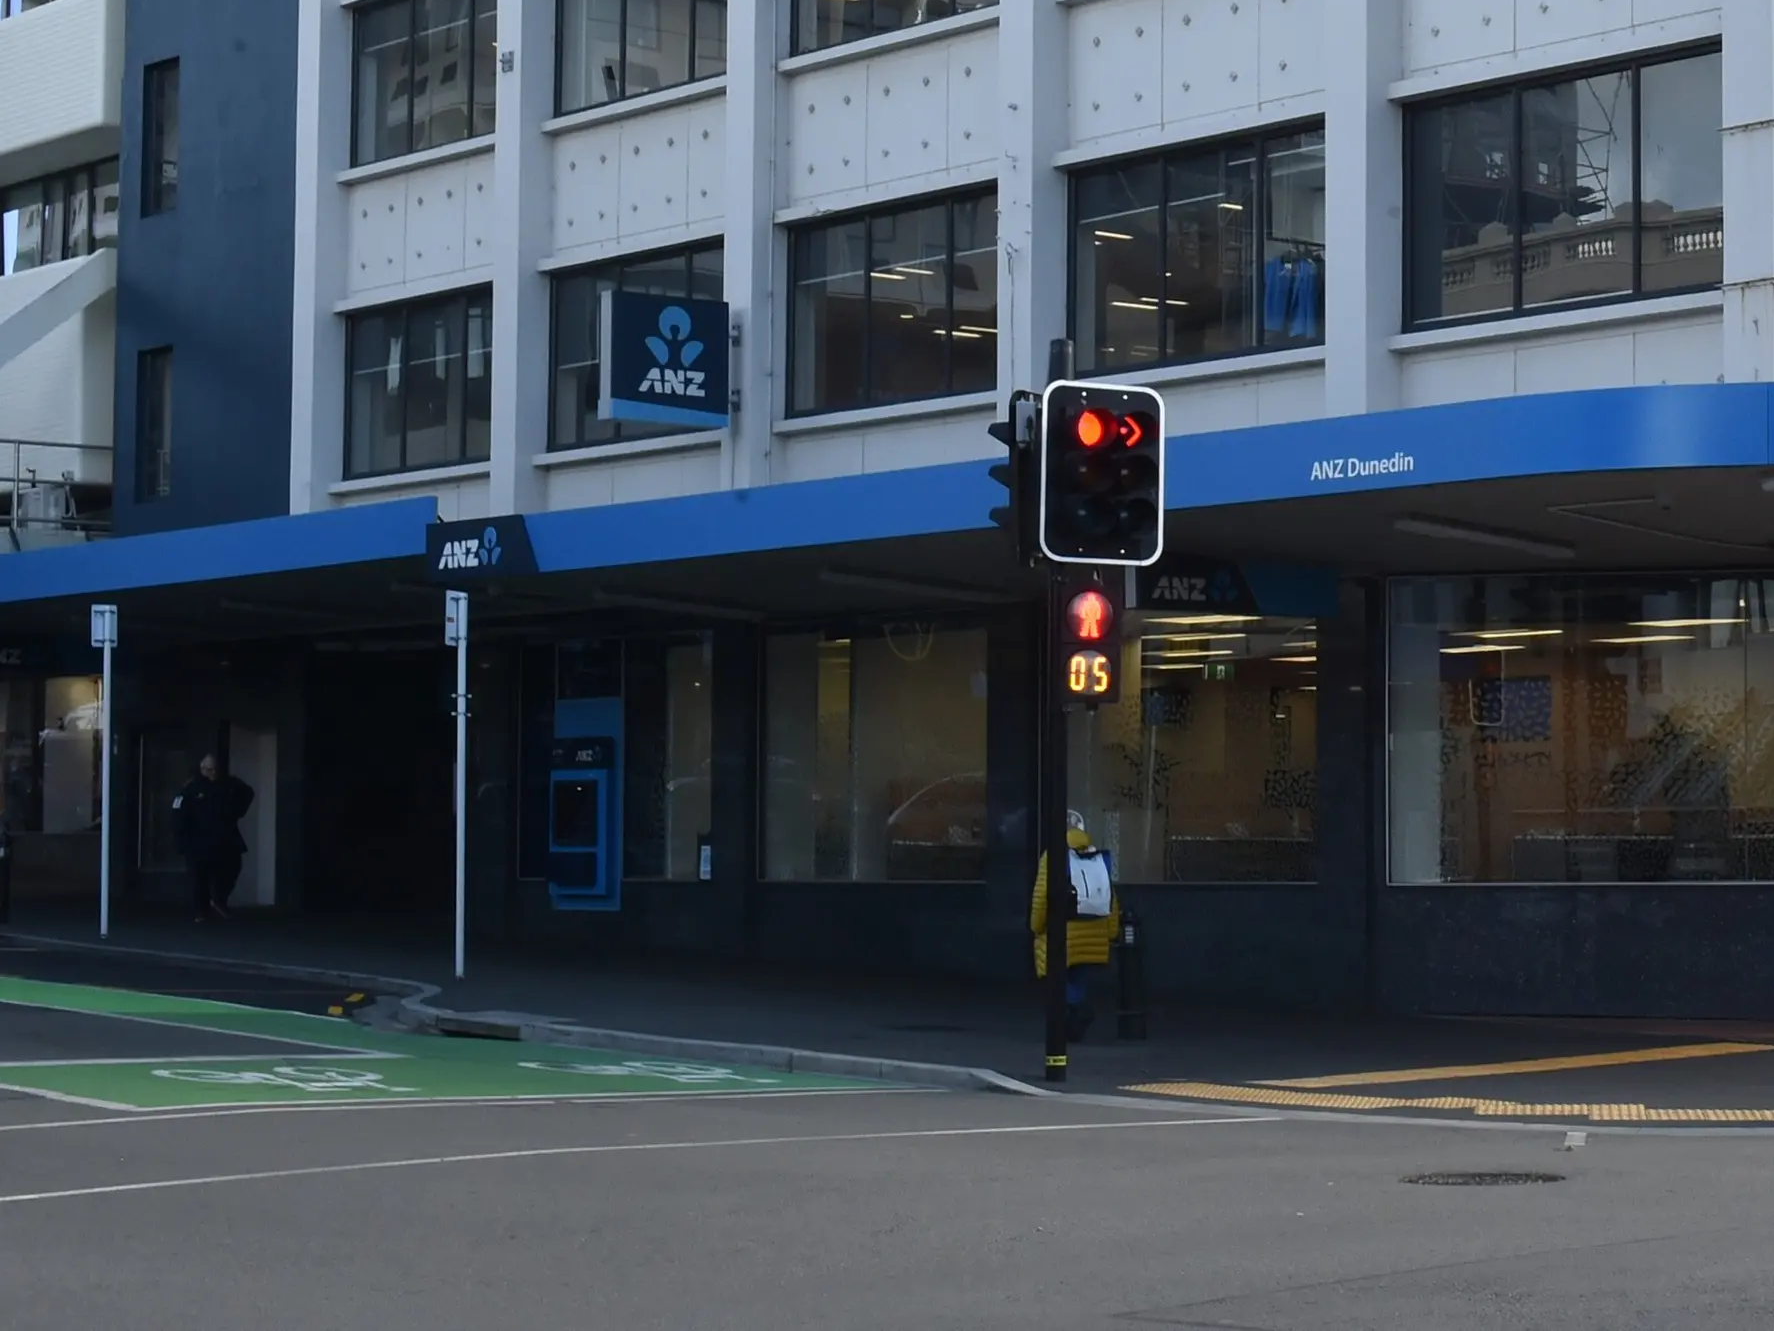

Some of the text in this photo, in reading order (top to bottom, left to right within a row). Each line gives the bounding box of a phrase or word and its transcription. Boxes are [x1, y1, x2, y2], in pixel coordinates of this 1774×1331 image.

[638, 367, 705, 397] ANZ
[1310, 452, 1414, 481] ANZ Dunedin
[438, 538, 480, 570] ANZ
[1152, 575, 1207, 601] ANZ
[1070, 655, 1108, 692] 05
